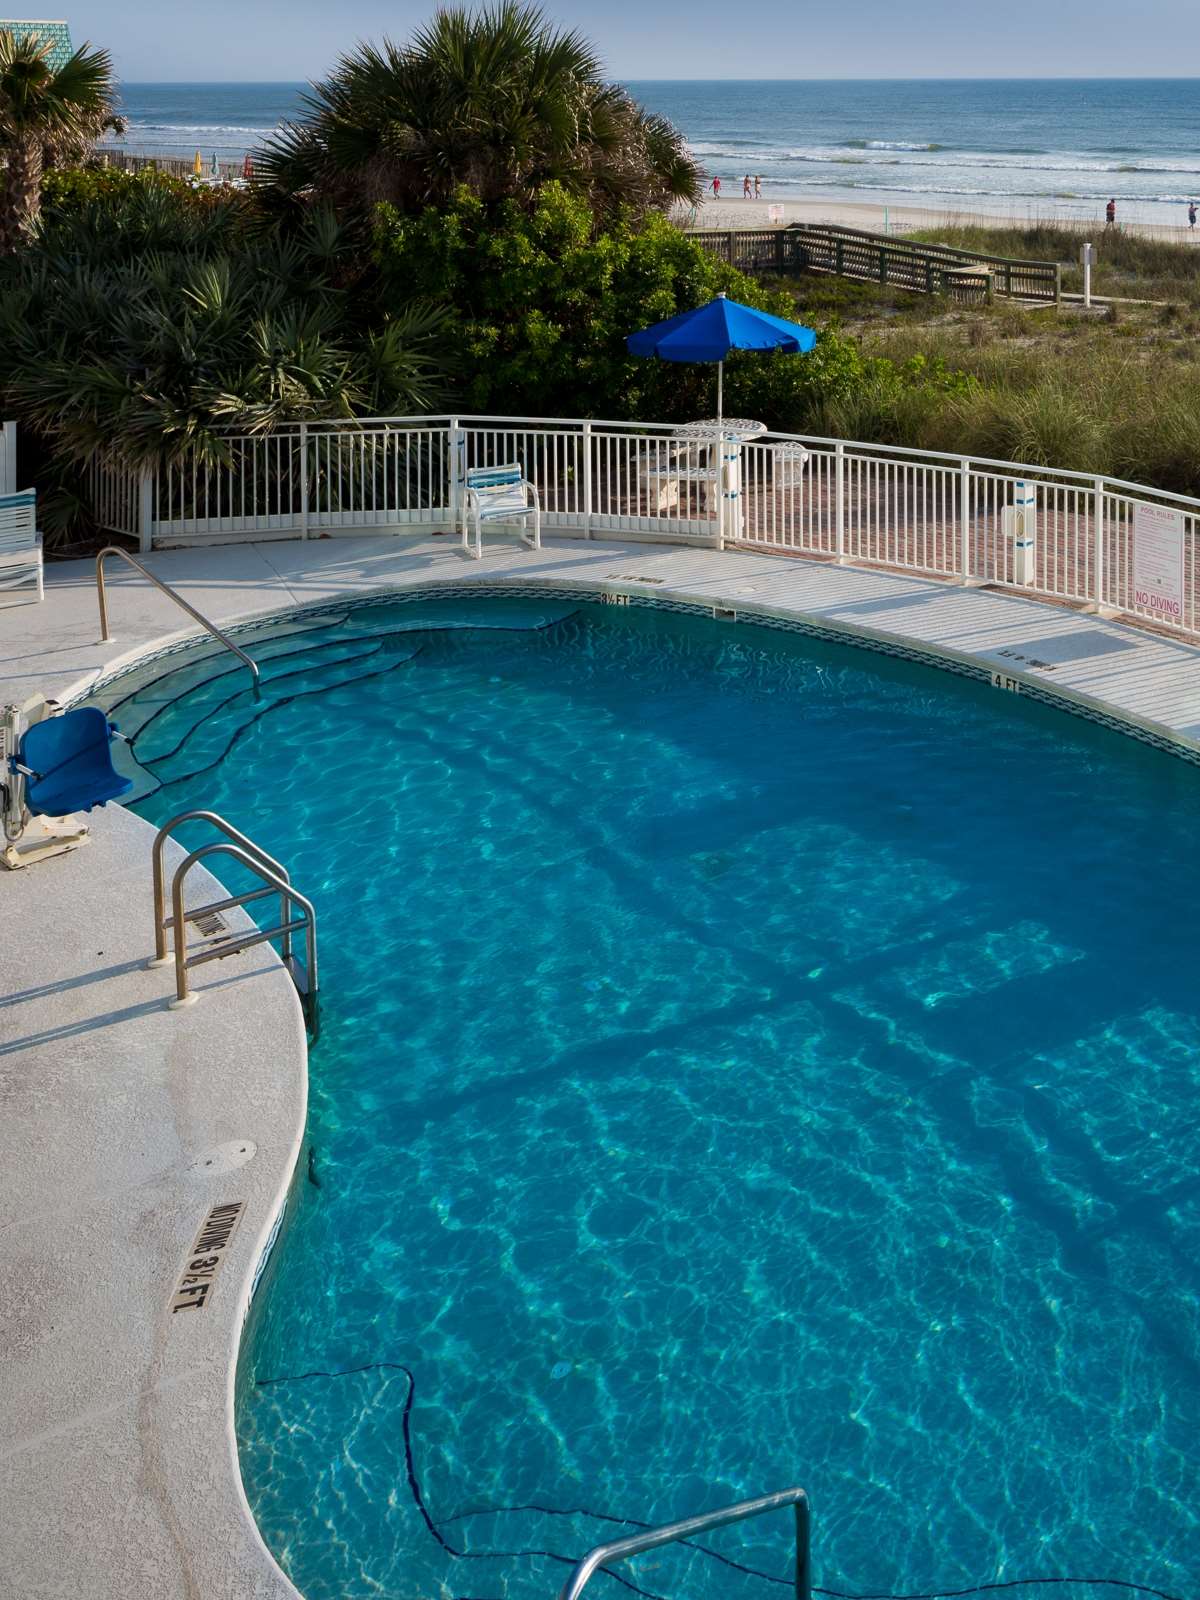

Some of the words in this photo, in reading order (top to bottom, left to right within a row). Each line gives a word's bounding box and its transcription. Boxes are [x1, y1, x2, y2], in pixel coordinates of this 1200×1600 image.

[1135, 591, 1149, 605] NO
[1150, 595, 1180, 615] DIVING
[995, 674, 1002, 689] 4
